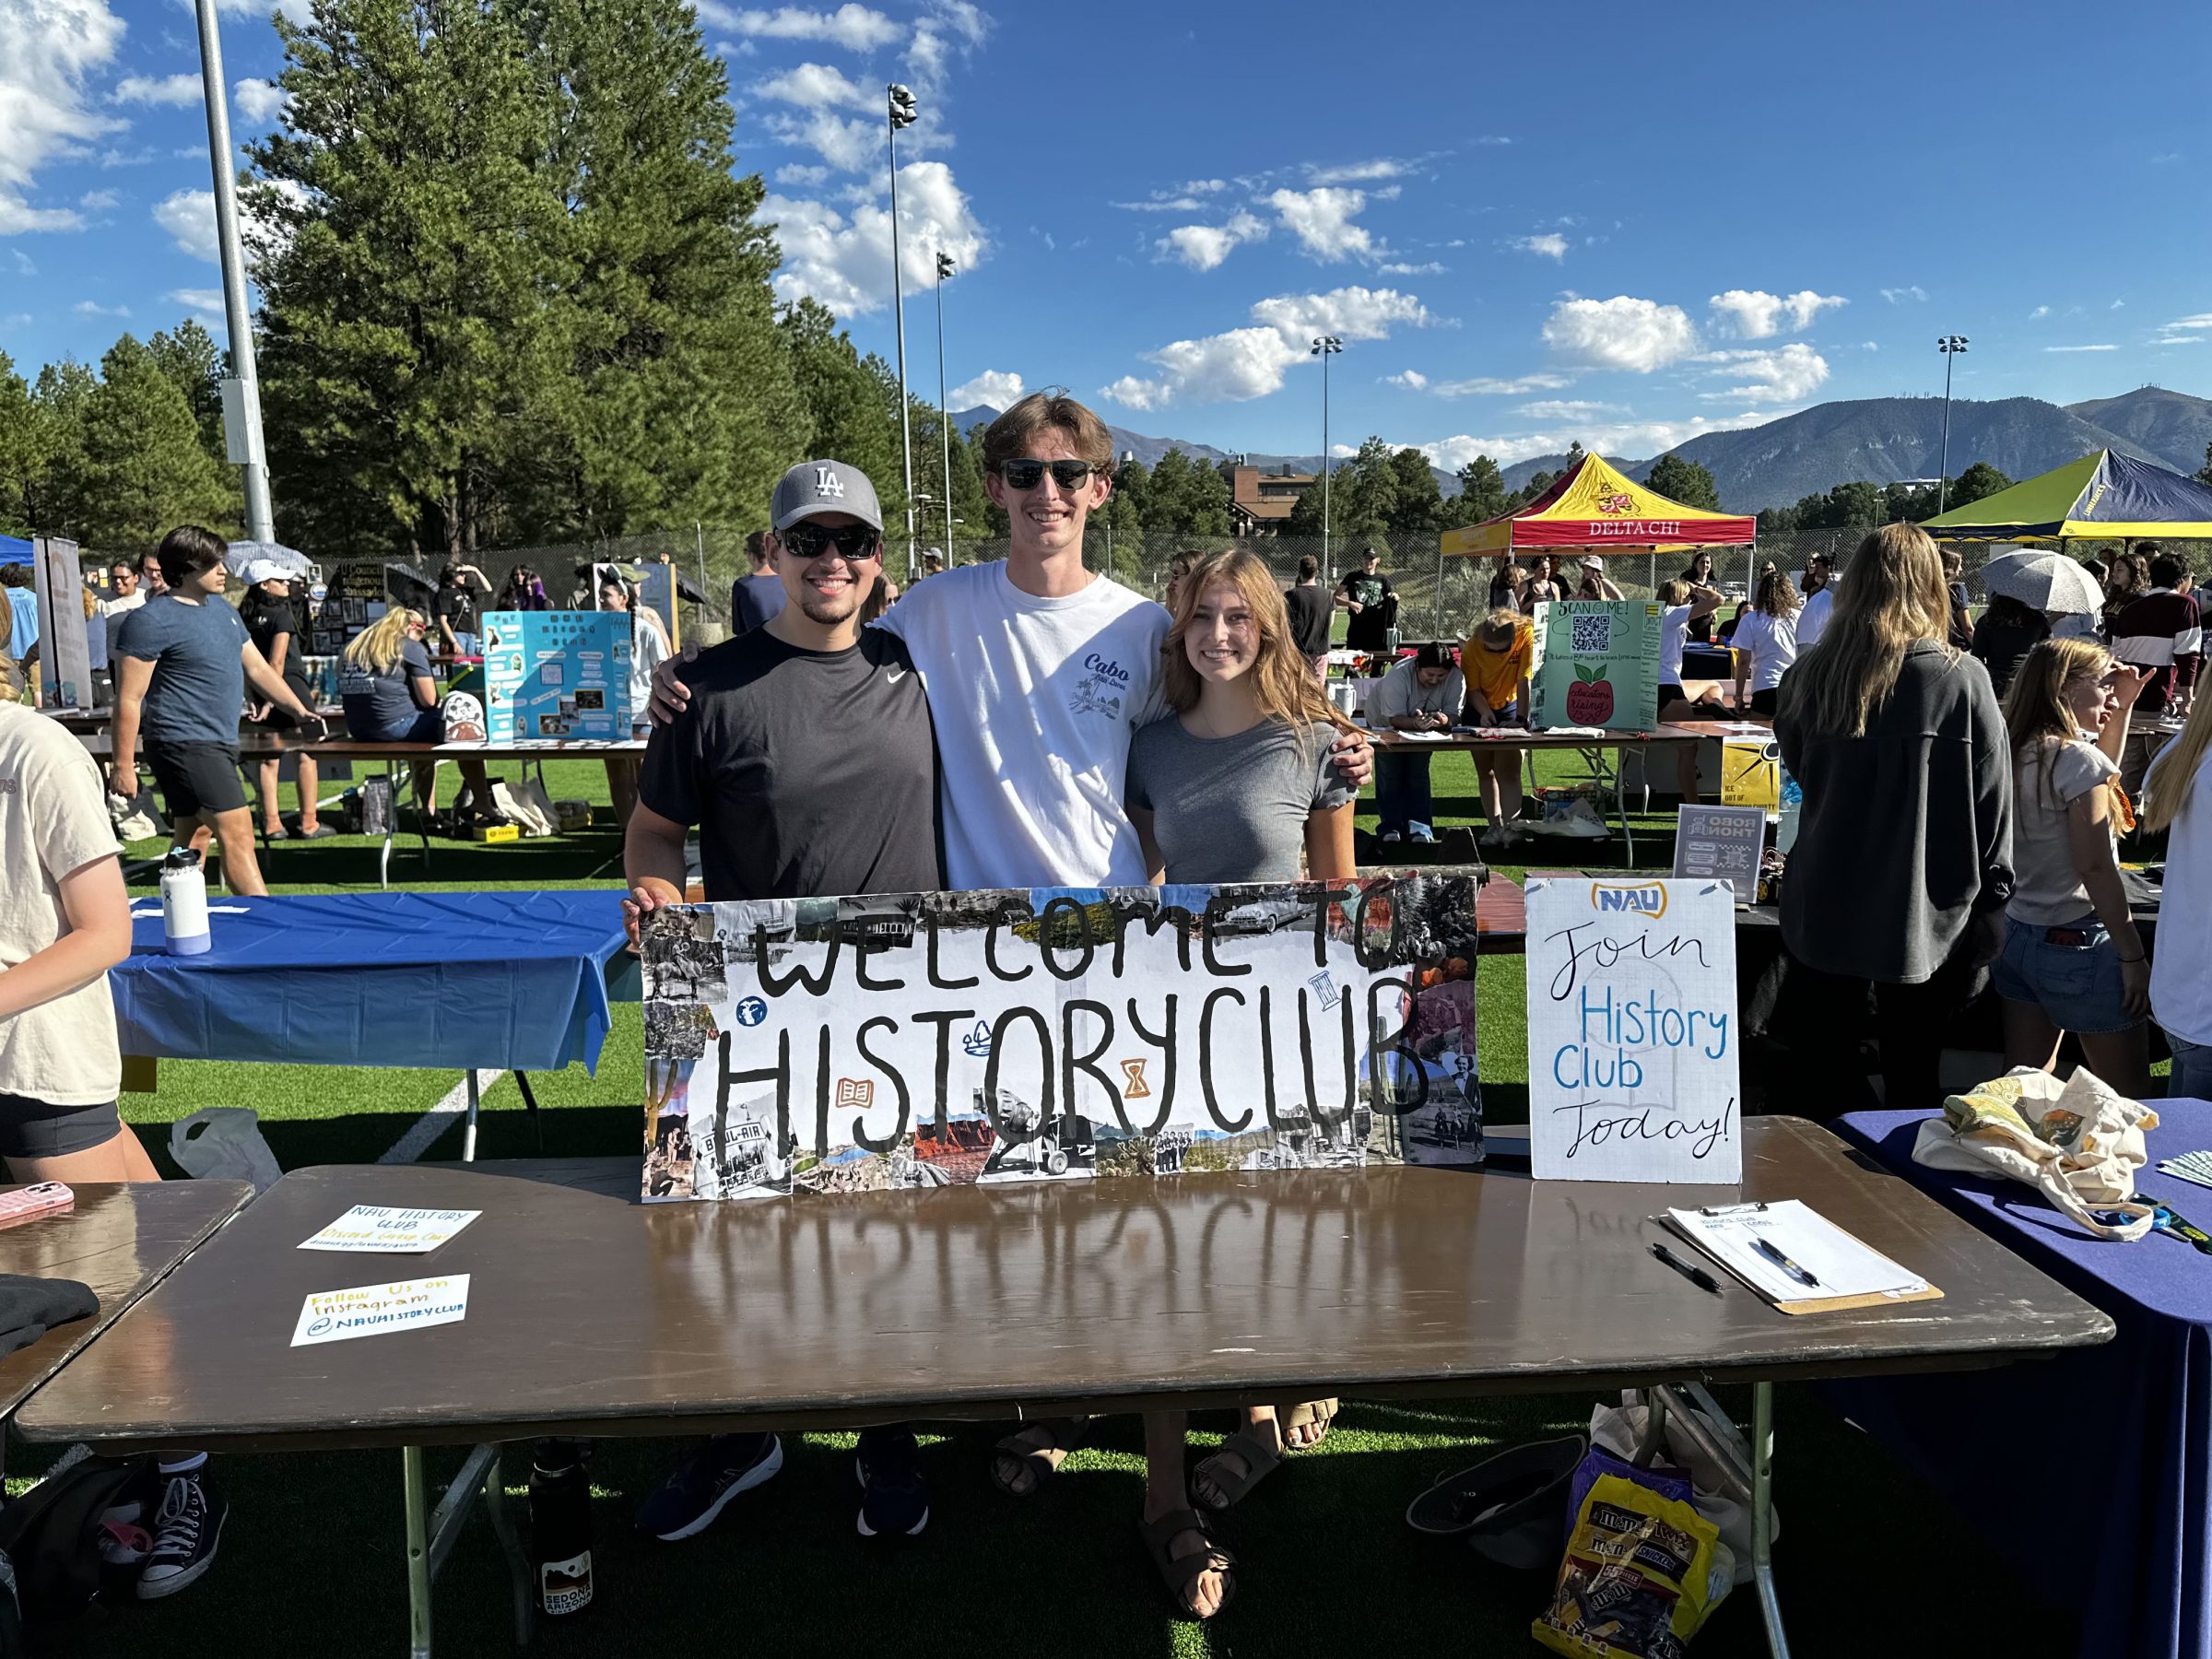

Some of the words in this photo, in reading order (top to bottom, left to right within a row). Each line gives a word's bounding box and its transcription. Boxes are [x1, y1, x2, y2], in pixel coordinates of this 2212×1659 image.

[816, 467, 844, 498] LA
[1590, 522, 1644, 535] DELTA
[1649, 522, 1681, 535] CHI
[349, 562, 383, 576] Council
[1559, 602, 1591, 616] SCAN
[1606, 602, 1629, 615] ME!
[1084, 653, 1130, 681] Cabo
[1599, 889, 1658, 912] NAU
[1297, 883, 1401, 969] TO
[1545, 922, 1712, 1001] Join
[1582, 985, 1728, 1060] History
[1554, 1044, 1643, 1089] Club
[1553, 1097, 1735, 1159] Today!
[351, 1206, 391, 1217] NAU
[398, 1210, 469, 1223] HISTORY
[377, 1219, 418, 1230] CLUB
[312, 1292, 370, 1306] Follow
[388, 1284, 412, 1294] Us
[424, 1280, 449, 1288] on
[314, 1294, 429, 1316] Instagram
[1603, 1565, 1619, 1577] 55
[546, 1583, 591, 1604] SEDONA
[547, 1592, 592, 1610] ARIZONA
